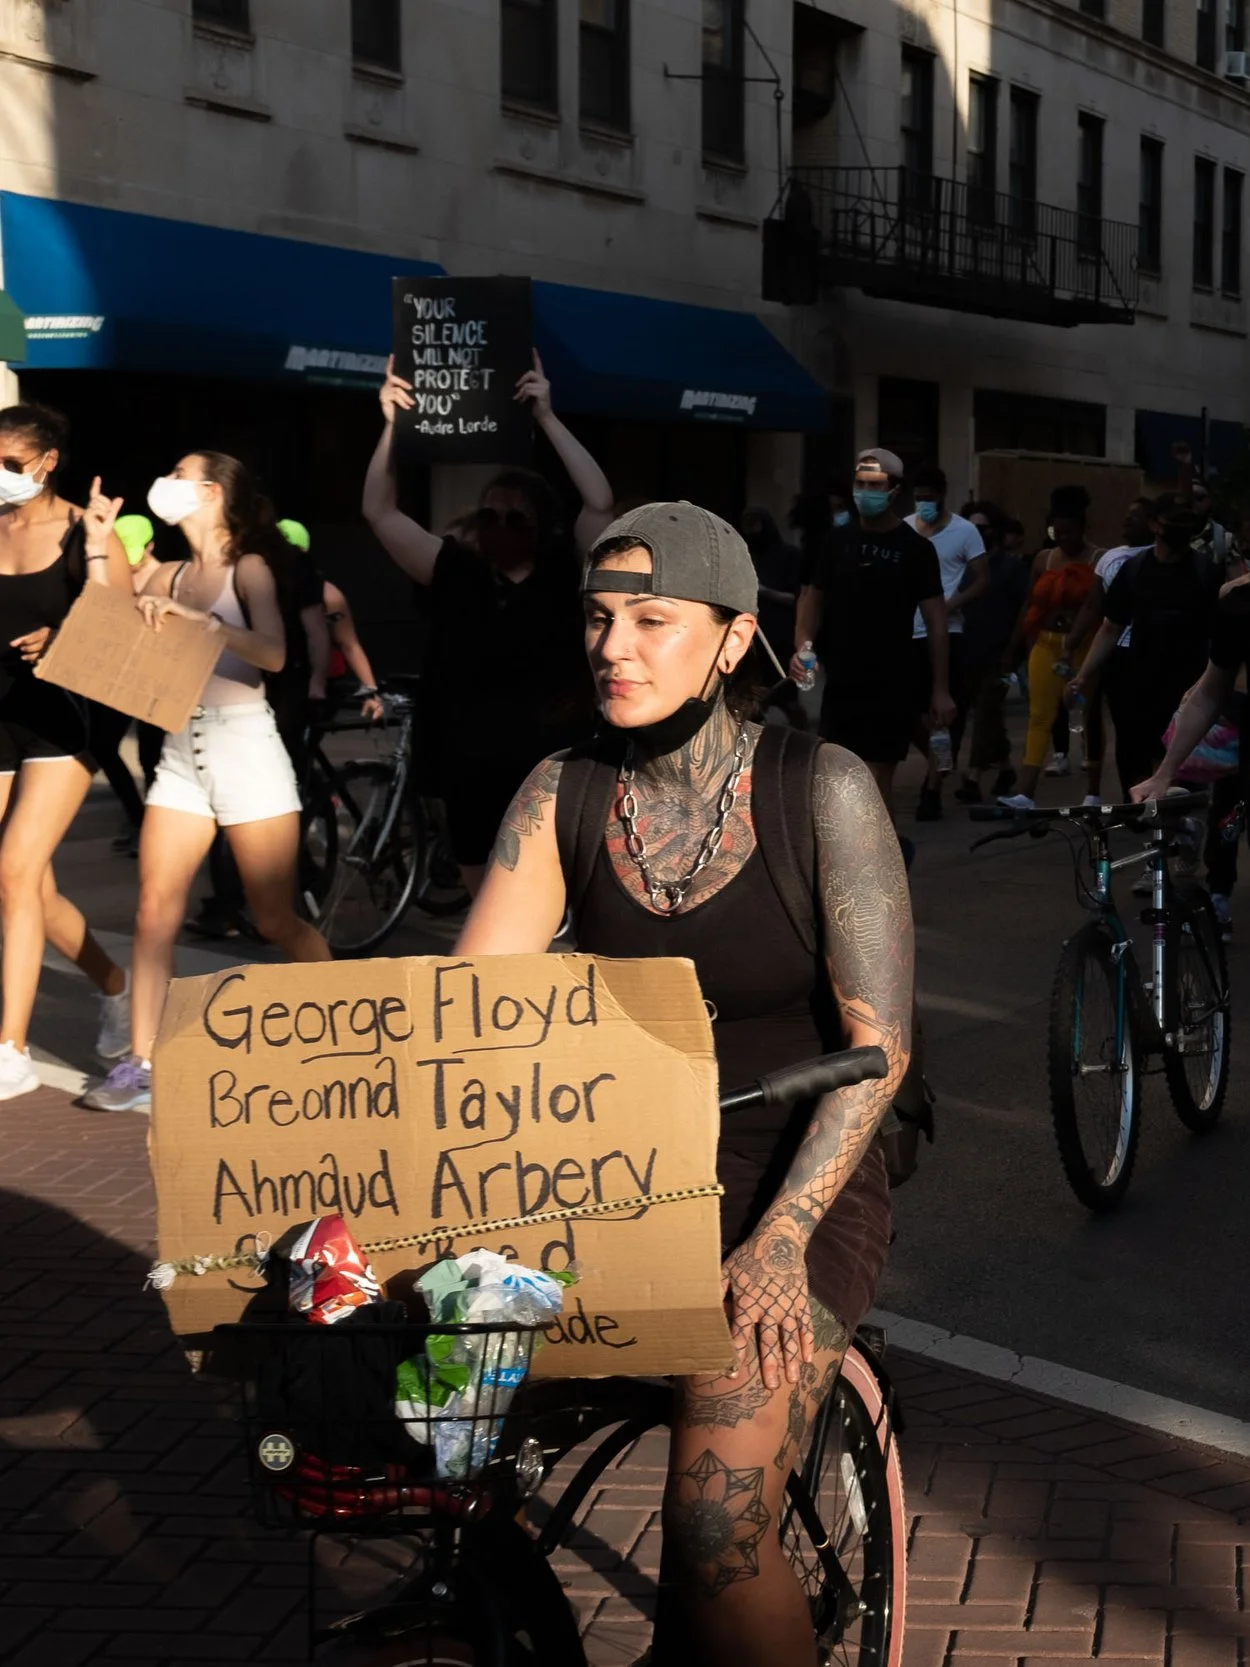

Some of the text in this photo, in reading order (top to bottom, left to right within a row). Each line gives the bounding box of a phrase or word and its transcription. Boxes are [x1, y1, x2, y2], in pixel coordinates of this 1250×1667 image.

[411, 320, 488, 345] SILENCE
[412, 347, 483, 366] WILL NOT
[414, 368, 495, 391] PROTECT
[458, 415, 498, 435] Lorde
[203, 961, 597, 1064] George Floyd
[209, 1056, 616, 1152] Breonna Taylor
[213, 1147, 657, 1224] Ahmaud Arbery
